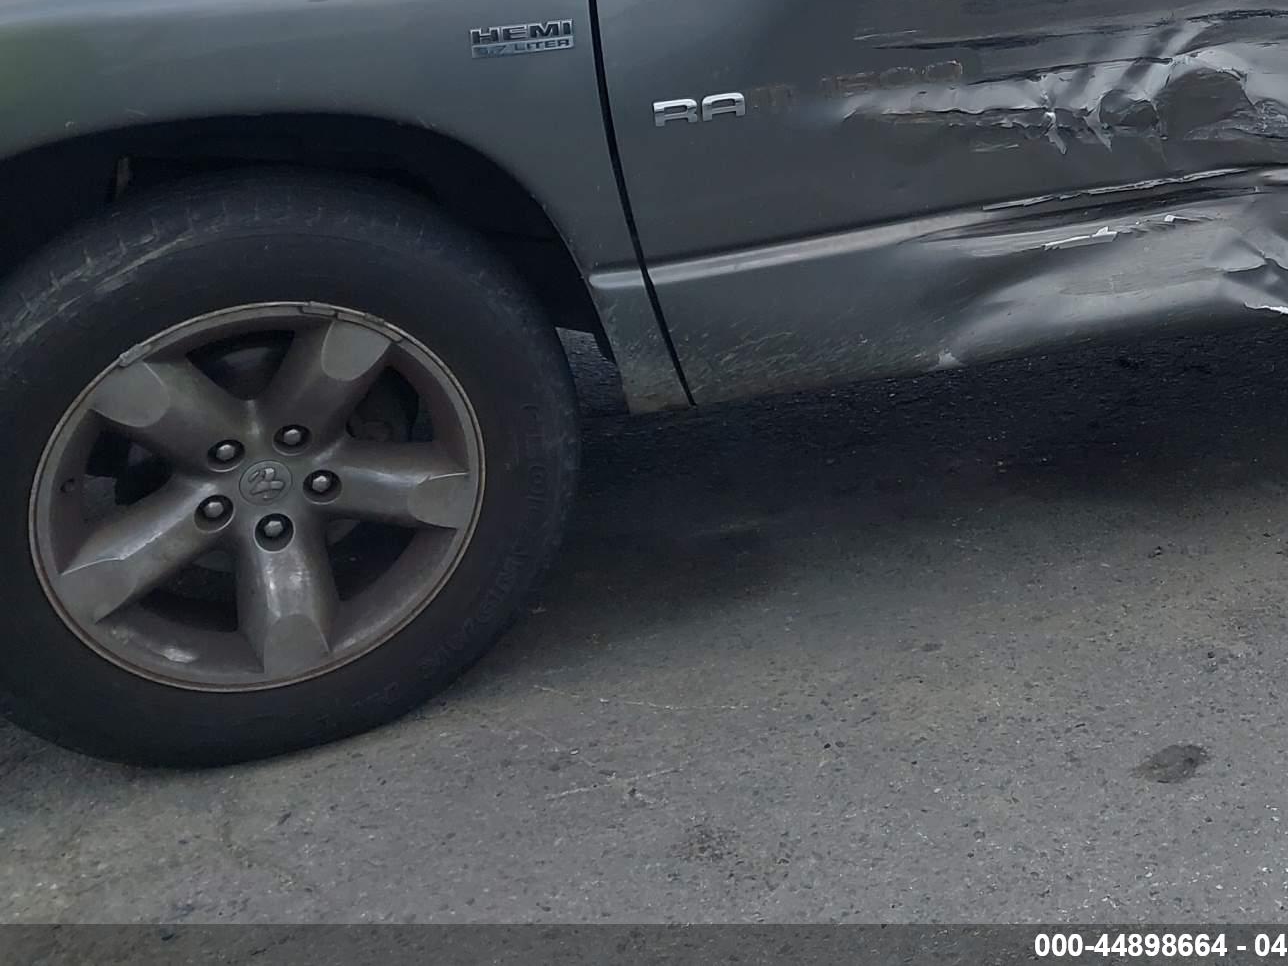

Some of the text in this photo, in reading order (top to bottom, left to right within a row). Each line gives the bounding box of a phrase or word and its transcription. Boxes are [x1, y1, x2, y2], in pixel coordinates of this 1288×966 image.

[470, 18, 573, 45] HEMI
[514, 39, 570, 53] LITER
[652, 92, 746, 127] RA
